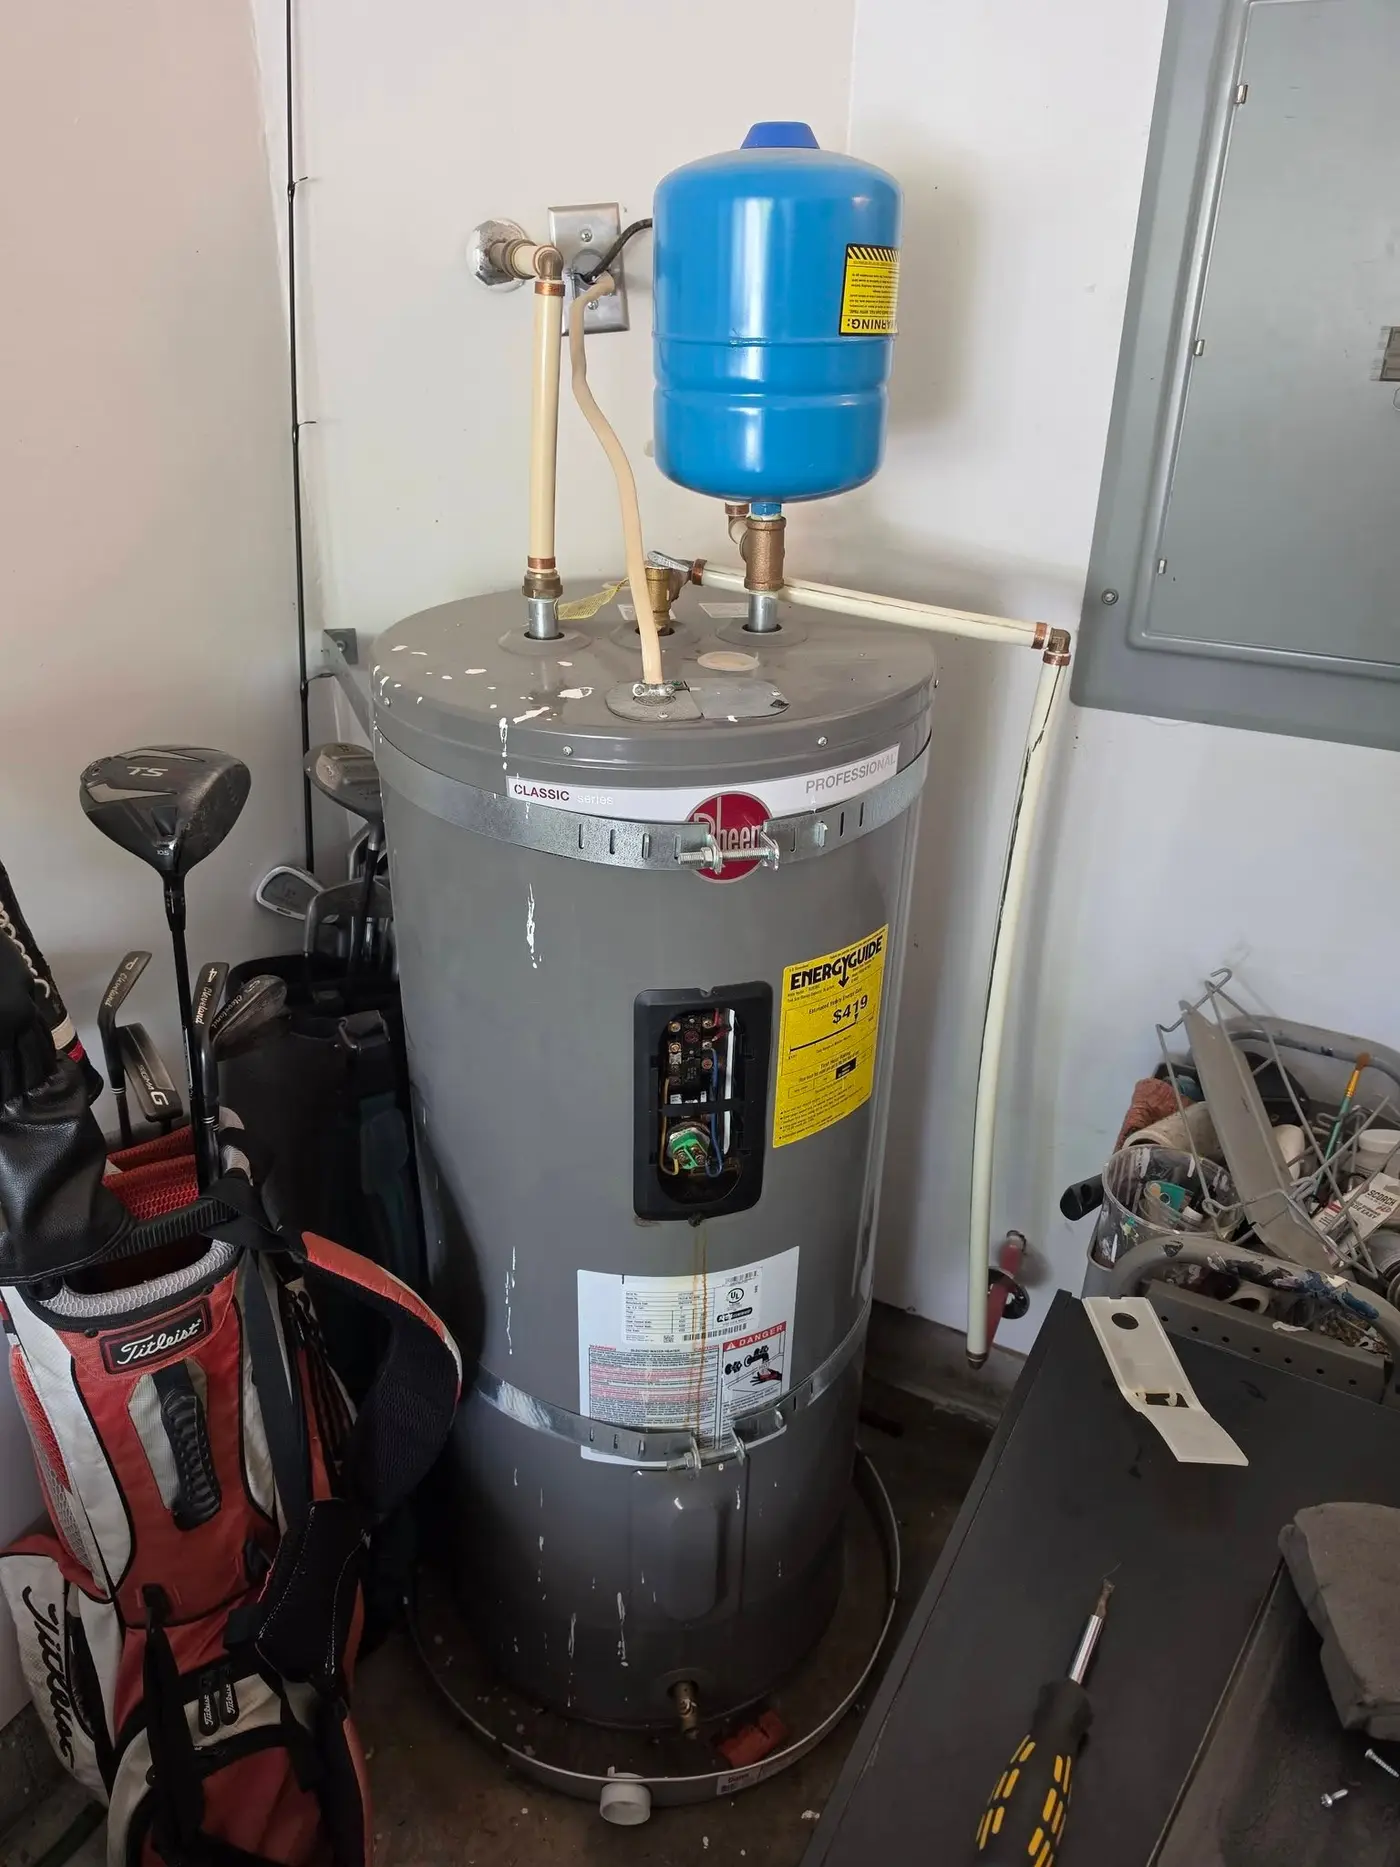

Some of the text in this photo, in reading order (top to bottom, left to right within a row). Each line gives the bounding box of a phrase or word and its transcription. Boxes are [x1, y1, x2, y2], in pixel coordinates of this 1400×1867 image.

[127, 766, 168, 777] TS
[806, 754, 896, 794] PROFESSIONAL
[514, 784, 613, 805] CLASSIC series
[207, 967, 218, 983] 4
[790, 935, 883, 991] ENERGYGUIDE
[195, 986, 212, 1025] Cleveland
[832, 994, 868, 1025] $419
[151, 1091, 169, 1106] G
[1367, 1189, 1397, 1206] SCORCH
[117, 1319, 202, 1364] Titleist
[739, 1325, 784, 1346] DANGER
[22, 1585, 74, 1770] Titleist
